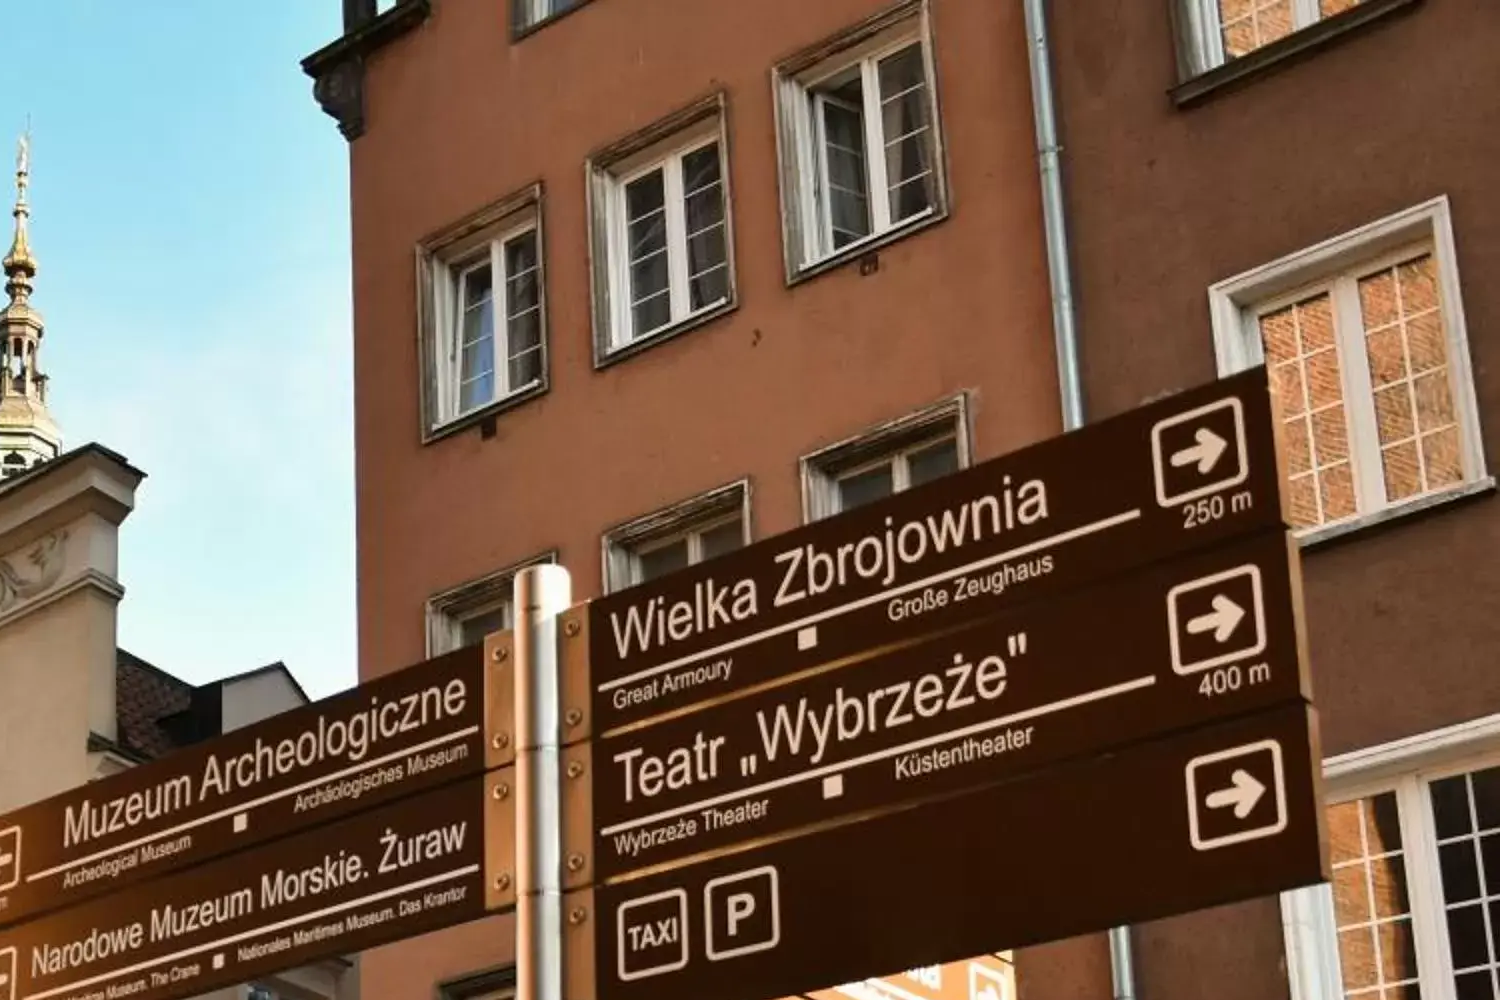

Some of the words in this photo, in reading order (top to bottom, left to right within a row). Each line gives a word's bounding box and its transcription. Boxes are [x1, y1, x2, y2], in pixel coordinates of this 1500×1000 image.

[1182, 495, 1225, 530] 250
[1232, 490, 1253, 512] m
[610, 576, 758, 660] Wielka
[773, 474, 1049, 608] Zbrojownia
[887, 588, 949, 621] Große
[954, 553, 1054, 602] Zeughaus
[613, 683, 659, 710] Great
[661, 658, 734, 697] Armoury
[1198, 667, 1242, 699] 400
[1249, 662, 1271, 684] m
[63, 772, 192, 848] Muzeum
[199, 678, 467, 801] Archeologiczne
[293, 764, 403, 813] Archäologisches
[407, 742, 469, 775] Museum
[613, 731, 726, 803] Teatr
[895, 724, 1035, 780] Küstentheater
[614, 817, 698, 857] Wybrzeże
[702, 798, 770, 832] Theater
[63, 848, 139, 889] Archeological
[141, 835, 192, 863] Museum
[31, 922, 143, 979] Narodowe
[150, 886, 253, 943] Muzeum
[261, 851, 370, 910] Morskie.
[378, 821, 468, 875] Żuraw
[726, 892, 756, 937] P
[237, 936, 291, 962] Nationales
[293, 922, 344, 947] Maritimes
[399, 899, 421, 917] Das
[627, 917, 678, 952] TAXI
[151, 971, 168, 988] The
